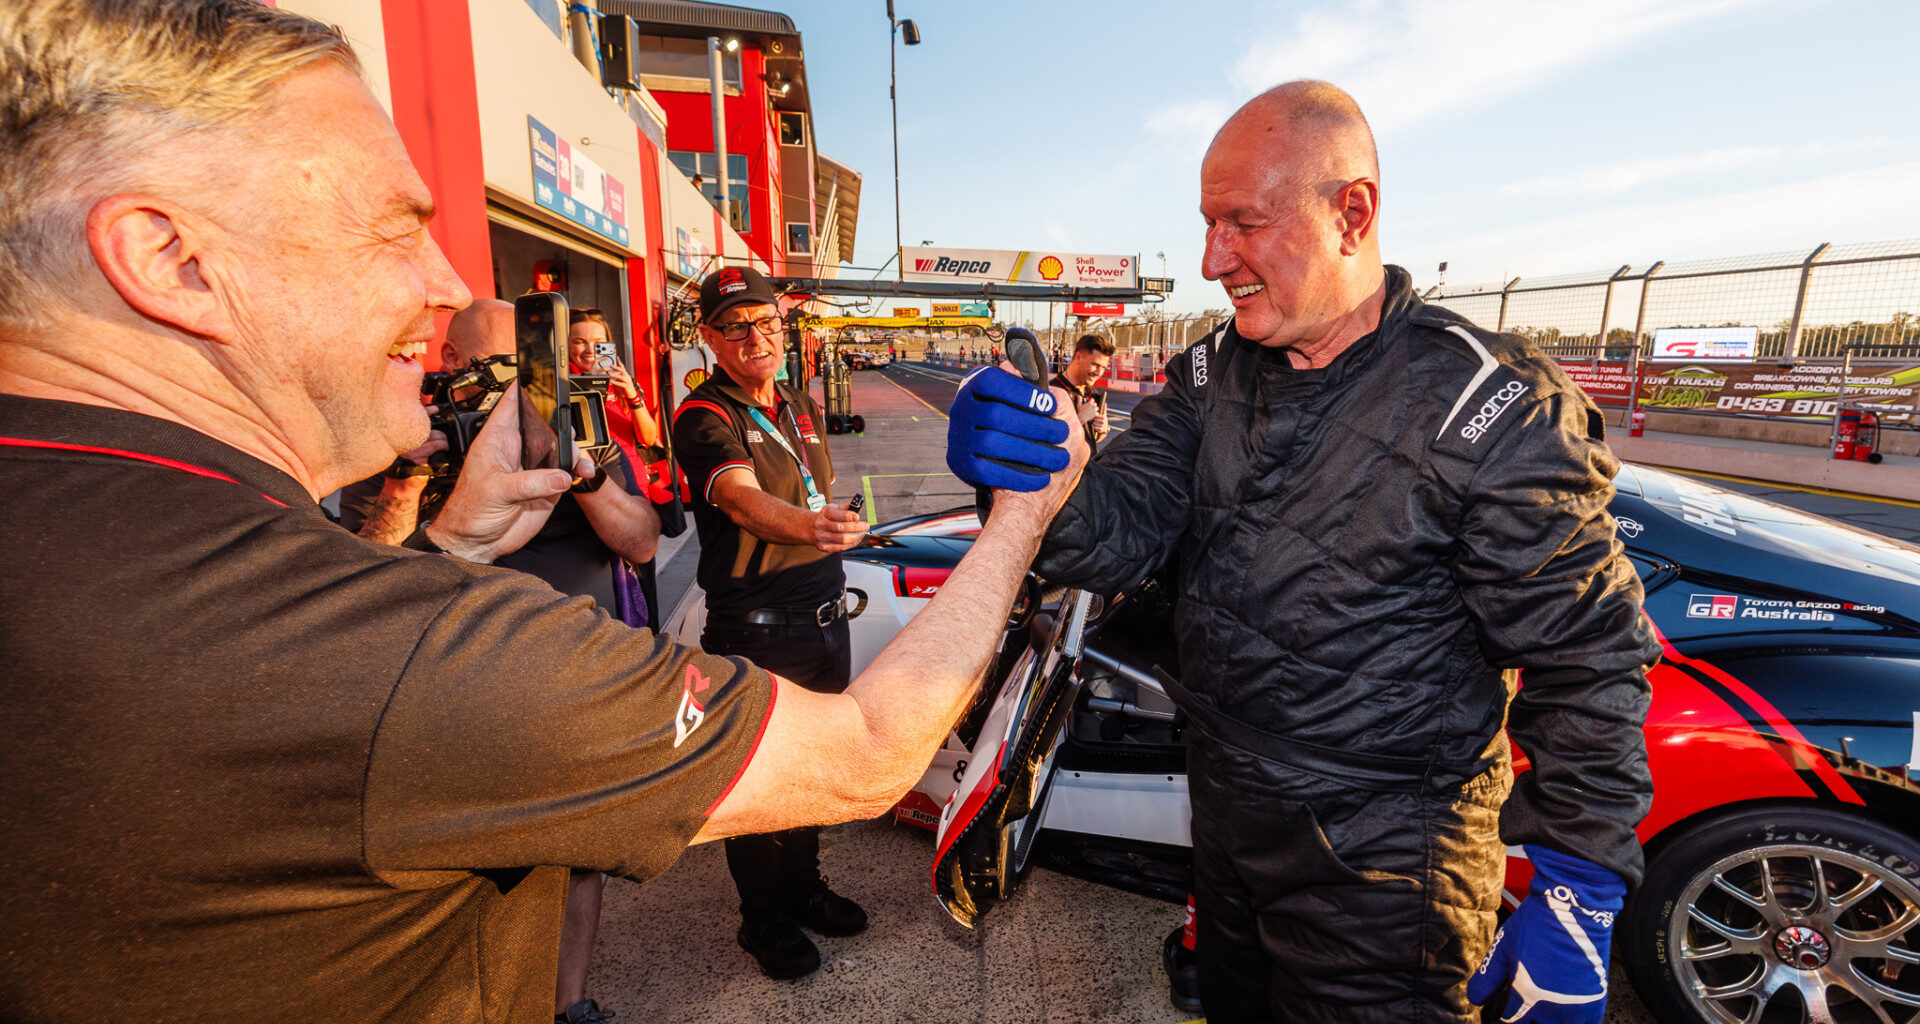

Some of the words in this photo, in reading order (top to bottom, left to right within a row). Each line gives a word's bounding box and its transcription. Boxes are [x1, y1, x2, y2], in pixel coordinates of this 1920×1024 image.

[934, 256, 991, 276] Repco
[1076, 256, 1095, 265] Shell
[1076, 266, 1126, 277] V-Power
[1079, 276, 1099, 284] Racing
[1194, 344, 1208, 386] sparco
[1600, 366, 1623, 374] TUNING
[1643, 376, 1670, 385] TOW
[1673, 376, 1727, 387] TRUCKS
[1863, 386, 1913, 396] TOWING
[1461, 380, 1526, 441] sparco
[1716, 395, 1787, 413] 0433
[1790, 398, 1839, 416] 810
[1689, 603, 1734, 618] GR
[1743, 598, 1794, 608] TOYOTA
[1795, 600, 1841, 610] GAZOO
[1843, 603, 1885, 614] Racing
[1740, 607, 1835, 622] Australia
